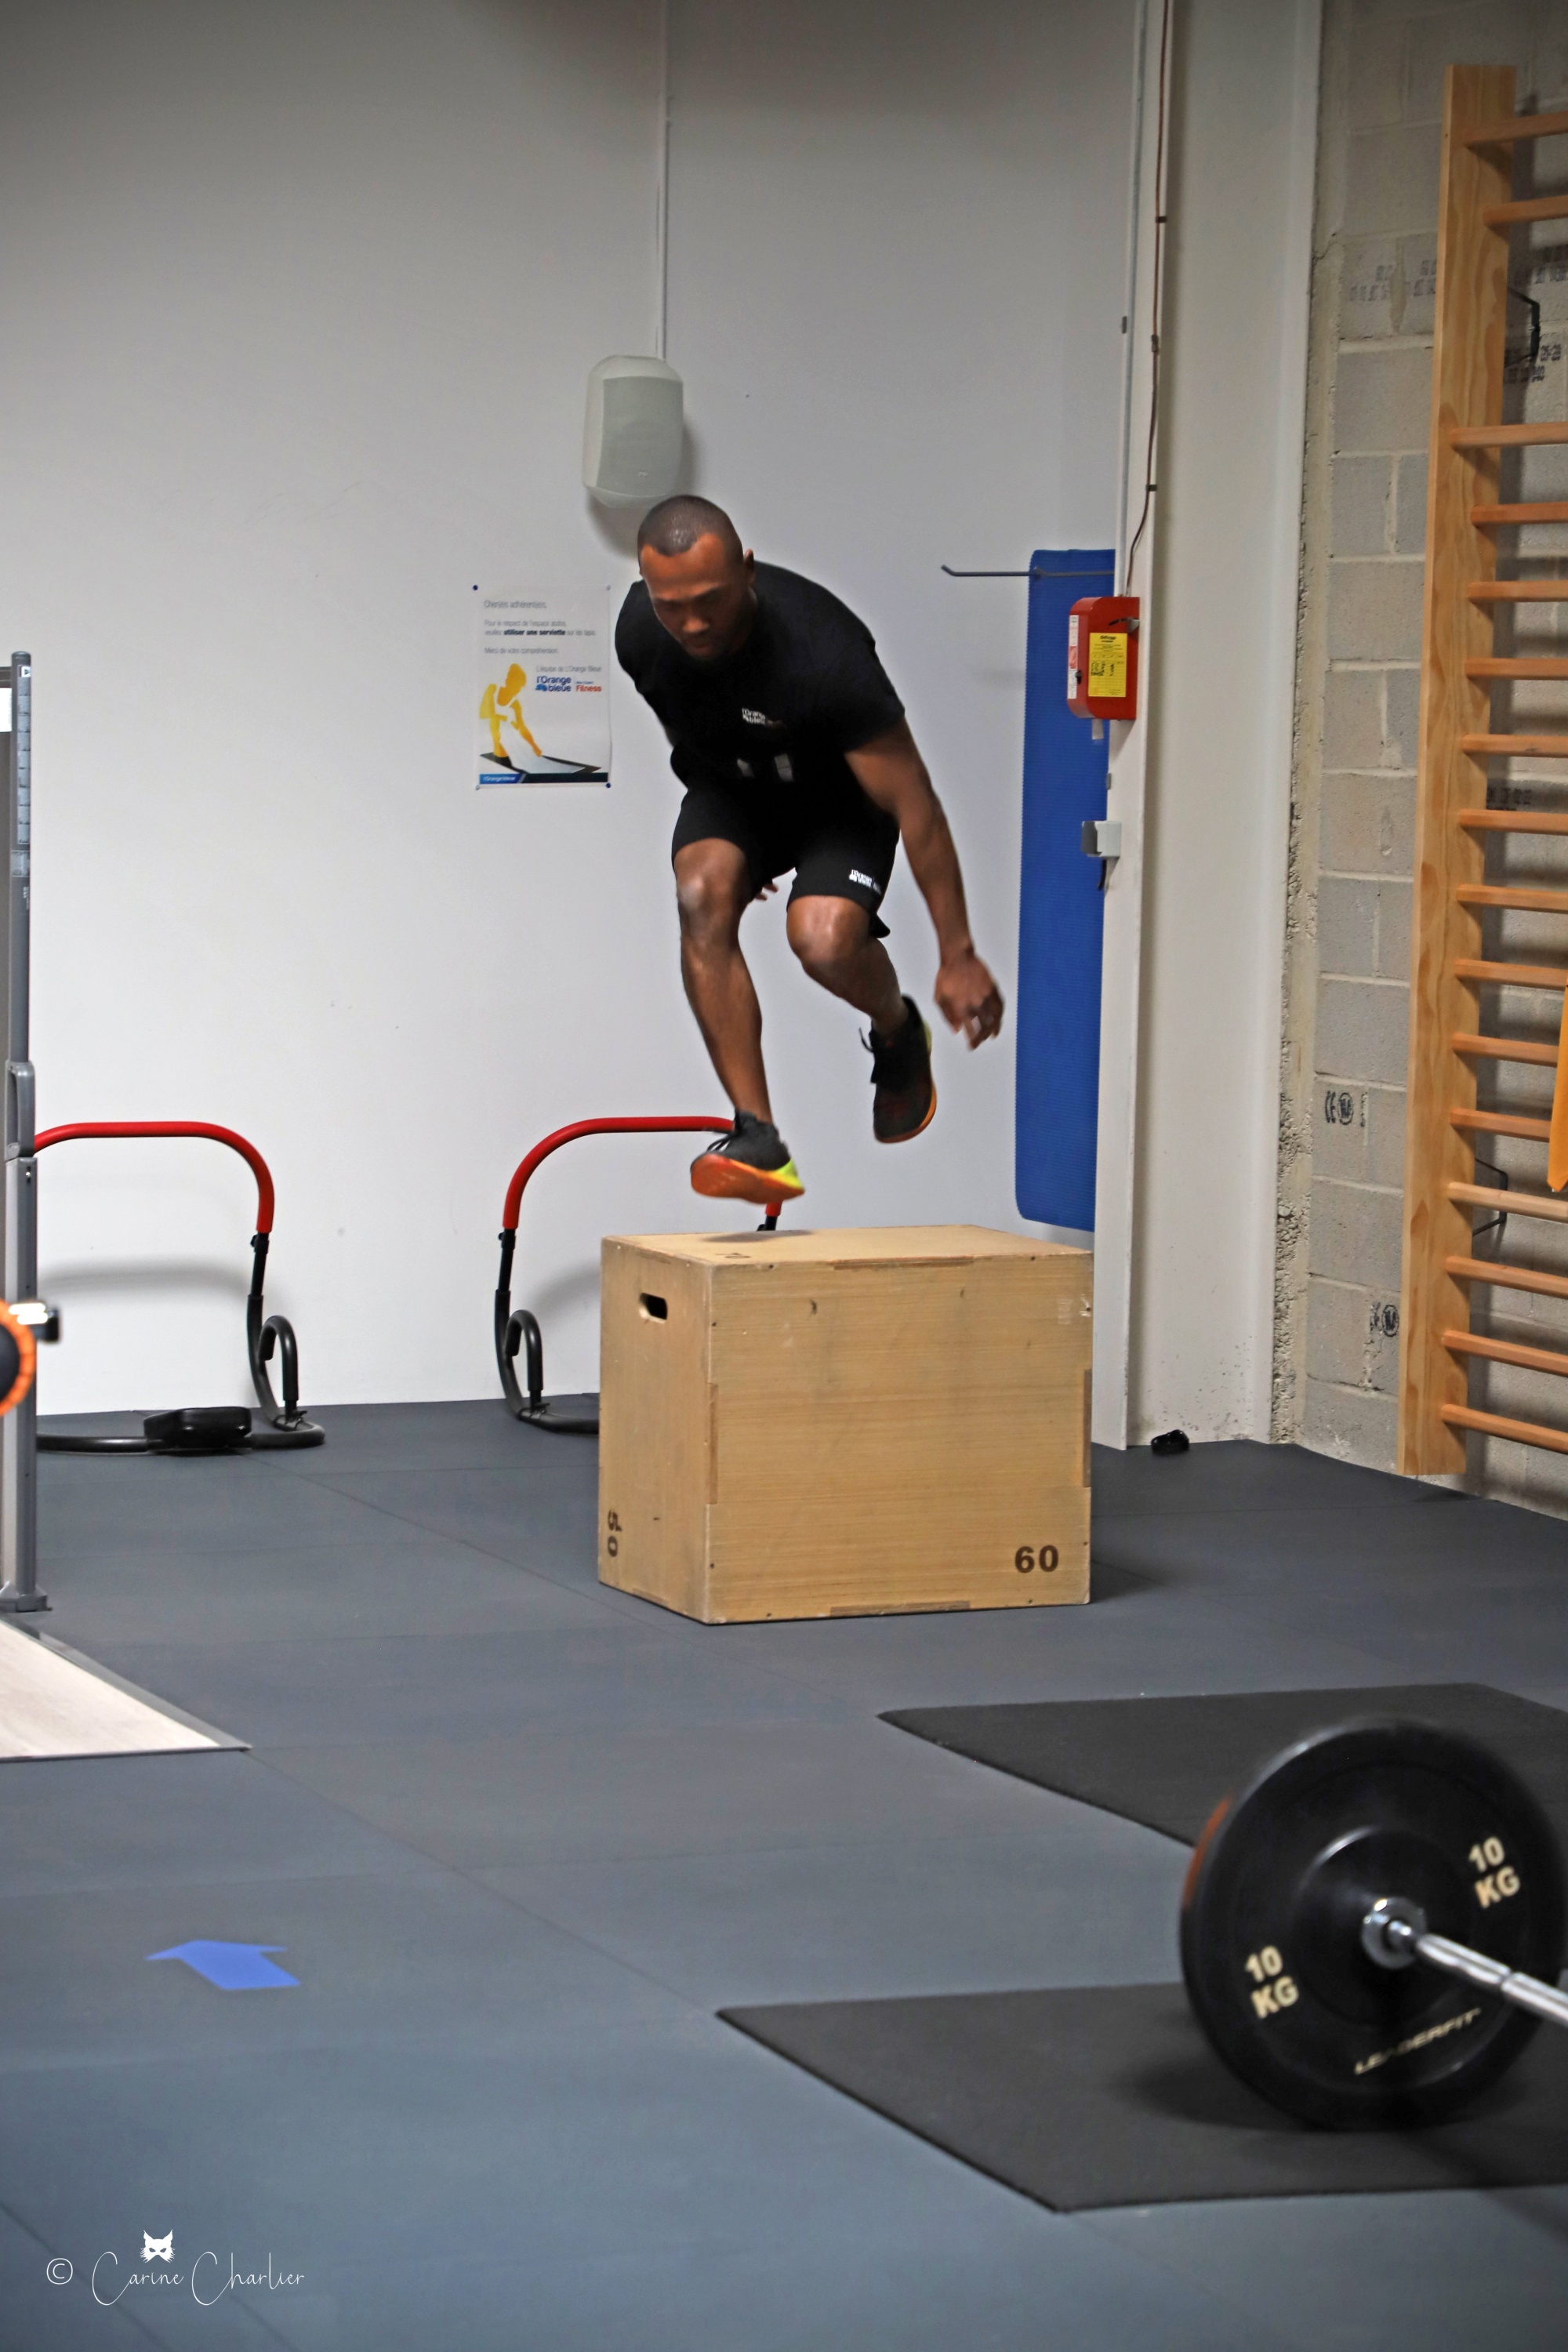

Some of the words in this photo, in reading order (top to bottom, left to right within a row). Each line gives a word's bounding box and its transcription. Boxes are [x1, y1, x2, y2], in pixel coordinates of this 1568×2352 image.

[608, 1508, 622, 1558] 50
[1014, 1544, 1059, 1574] 60
[1468, 1836, 1505, 1872] 10
[1475, 1866, 1521, 1908] KG
[1245, 1945, 1283, 1984] 10
[1250, 1976, 1299, 2018] KG
